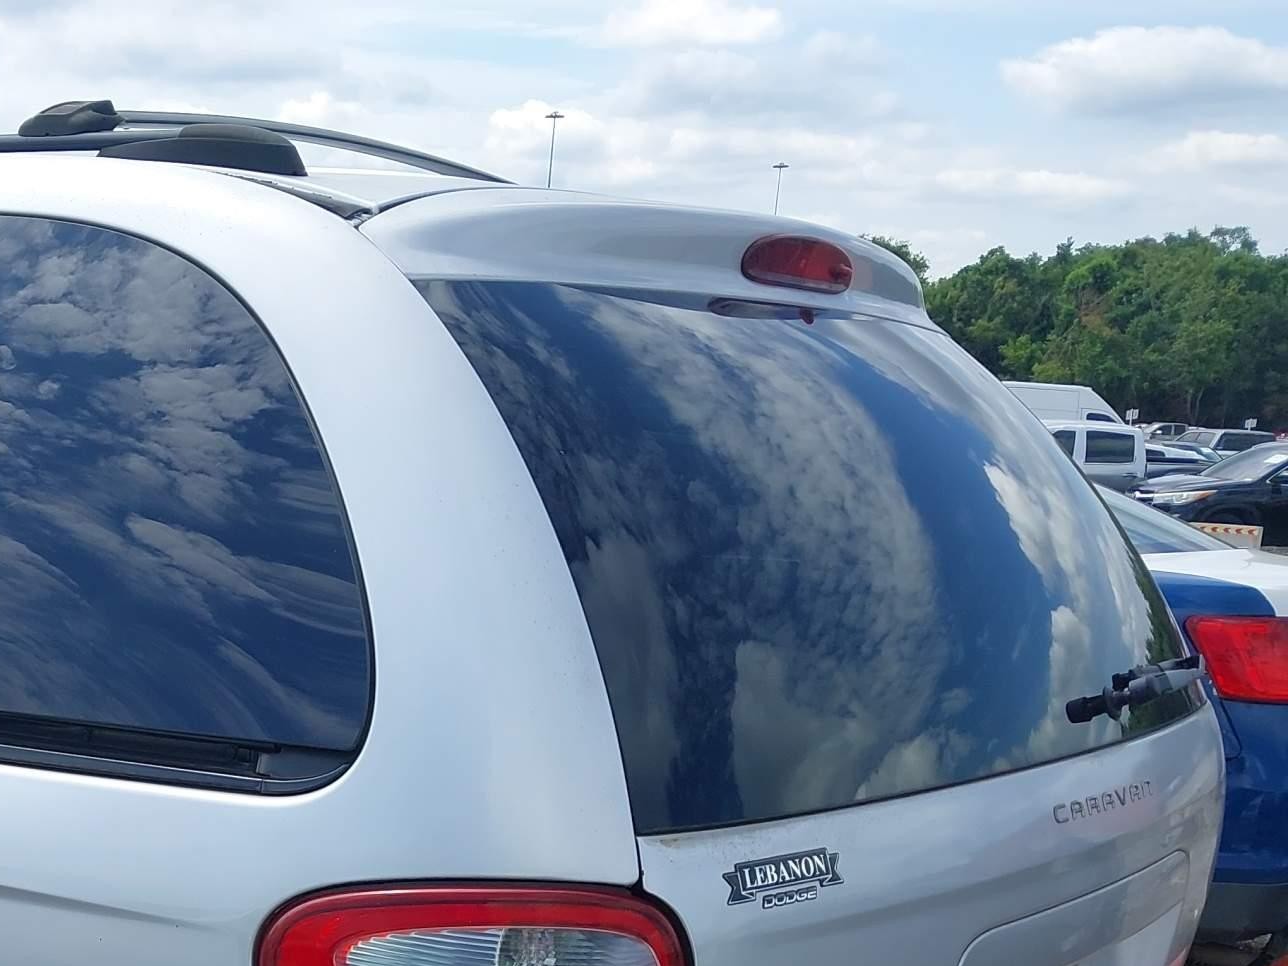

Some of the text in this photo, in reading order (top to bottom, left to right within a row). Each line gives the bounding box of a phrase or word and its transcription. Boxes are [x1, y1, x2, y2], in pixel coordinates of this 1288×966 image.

[1053, 781, 1152, 824] CARAVAN
[742, 854, 827, 889] LEBANON
[763, 887, 817, 908] DODGE
